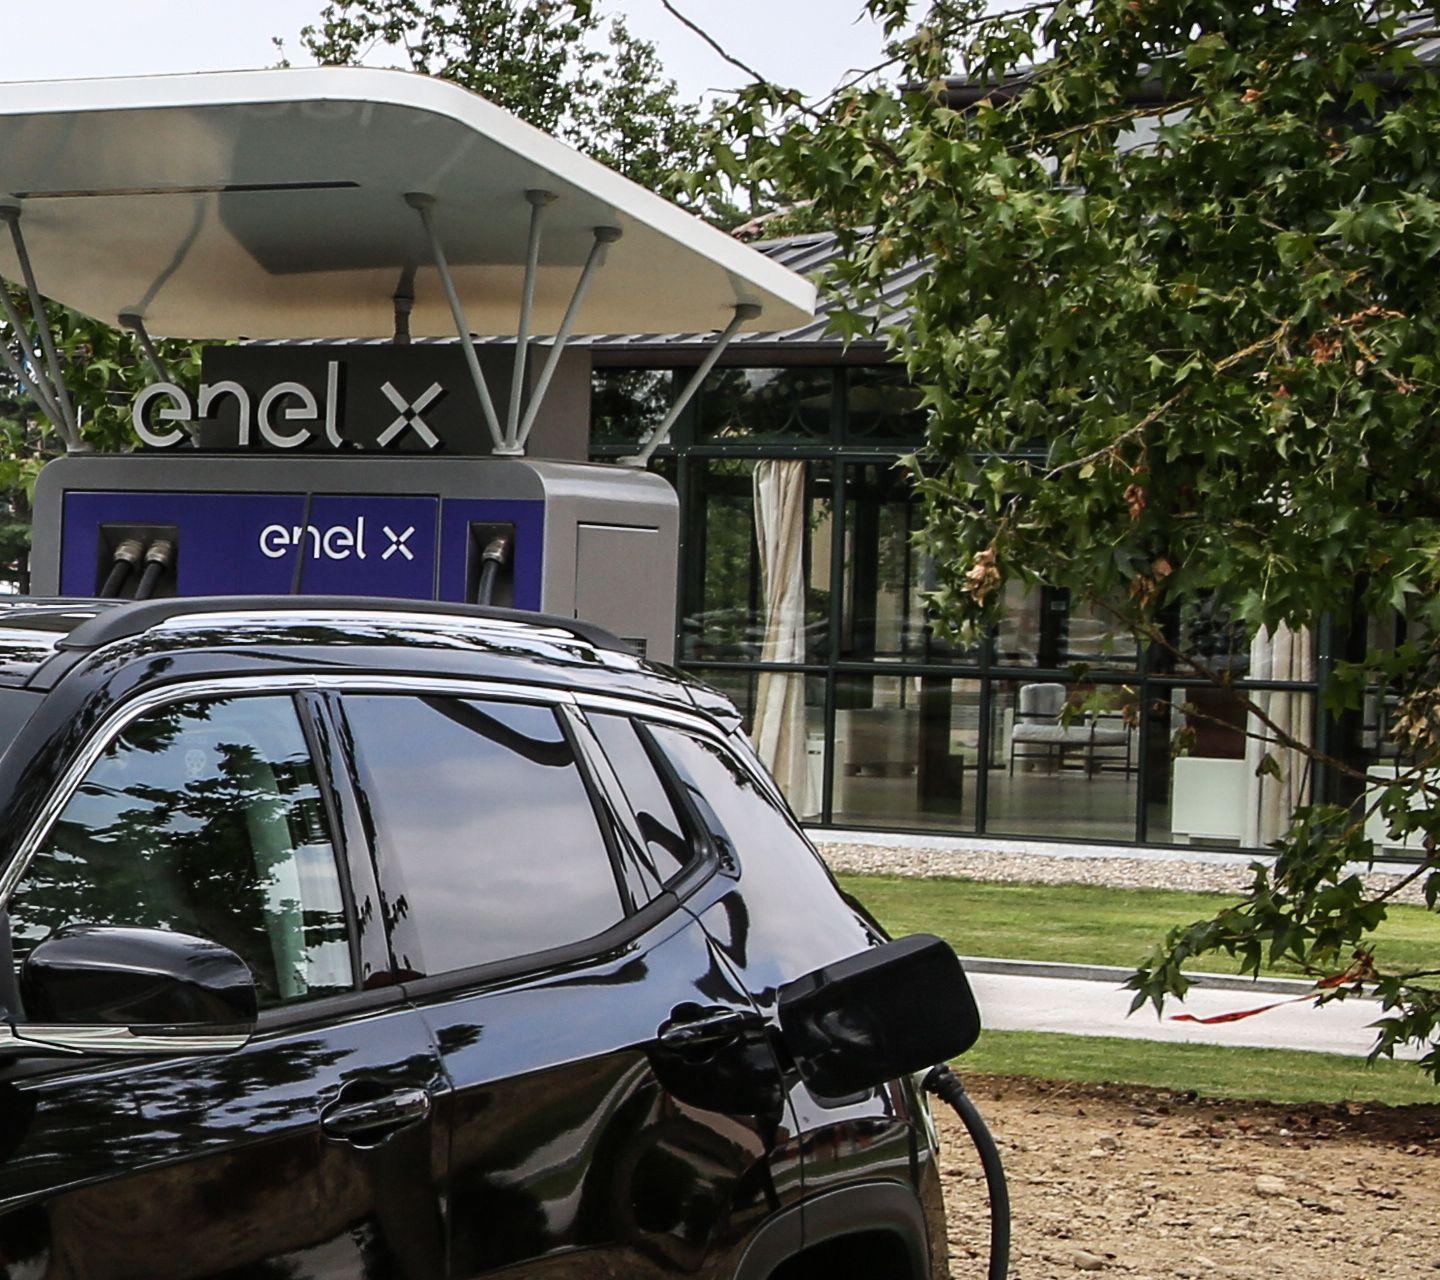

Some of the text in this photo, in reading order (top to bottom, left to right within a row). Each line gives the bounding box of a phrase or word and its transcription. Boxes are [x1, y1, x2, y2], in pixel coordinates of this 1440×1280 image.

[132, 361, 444, 448] enel x
[259, 516, 415, 560] enel x
